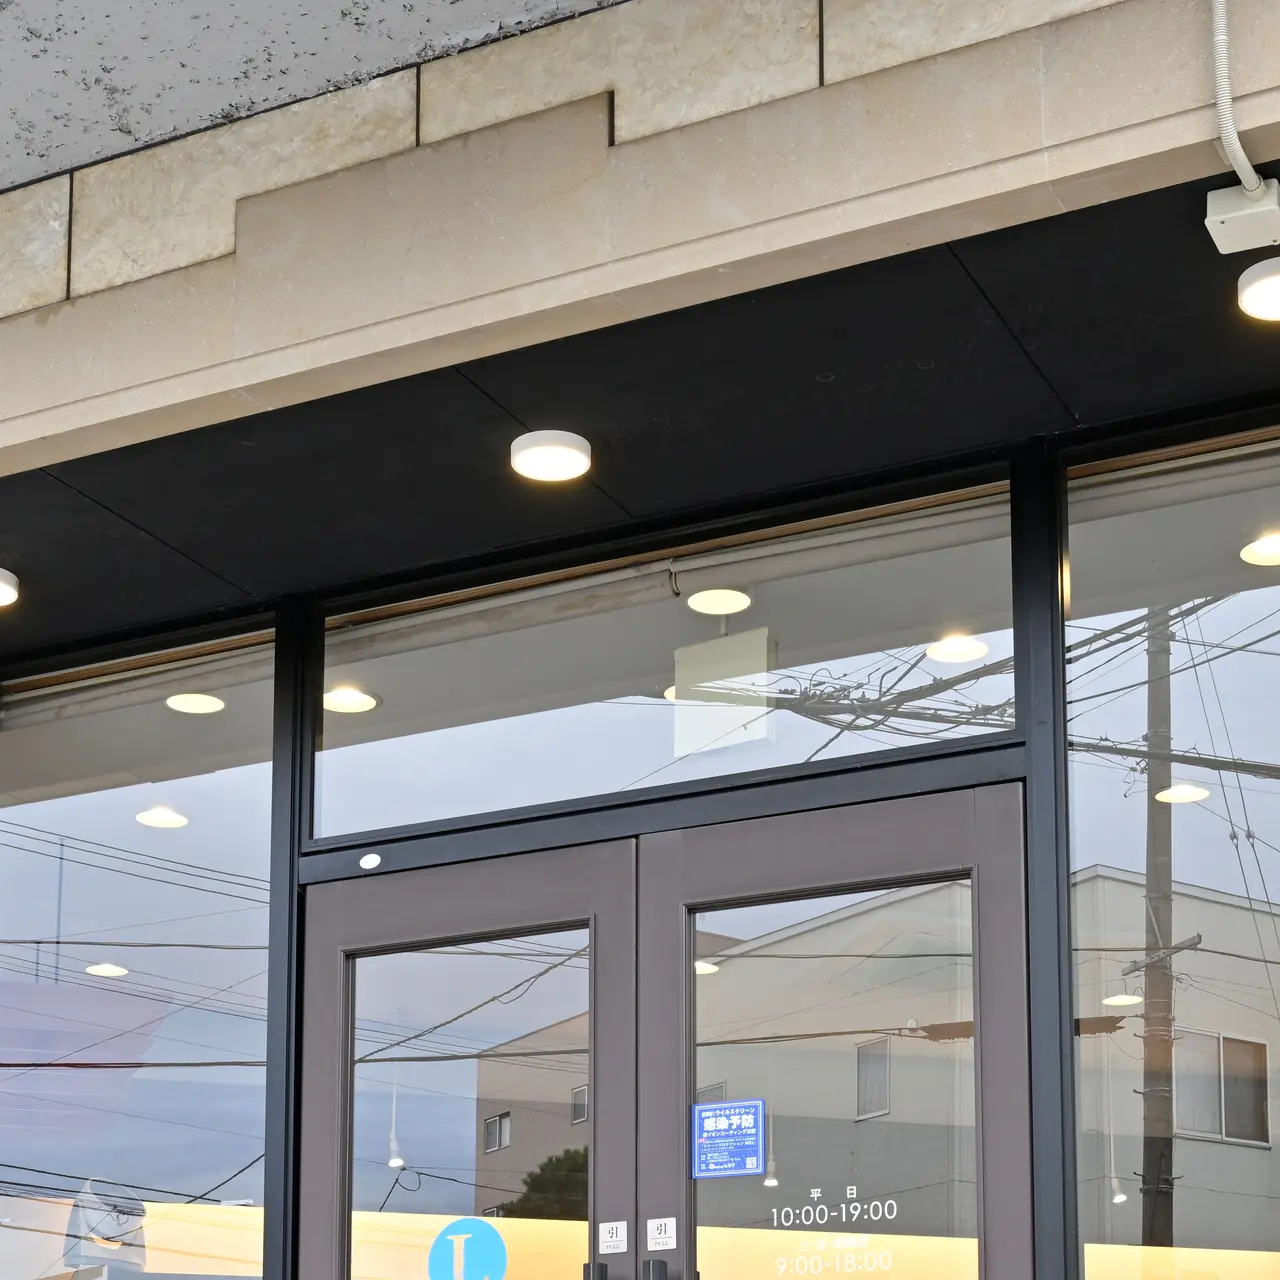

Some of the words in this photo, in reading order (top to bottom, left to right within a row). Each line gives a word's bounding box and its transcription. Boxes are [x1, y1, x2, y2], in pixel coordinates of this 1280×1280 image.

[703, 1114, 755, 1131] 感染予防
[771, 1199, 898, 1227] 10:00-19:00
[608, 1226, 618, 1238] 引
[656, 1222, 667, 1235] 引
[776, 1251, 893, 1277] 9:00-18:00
